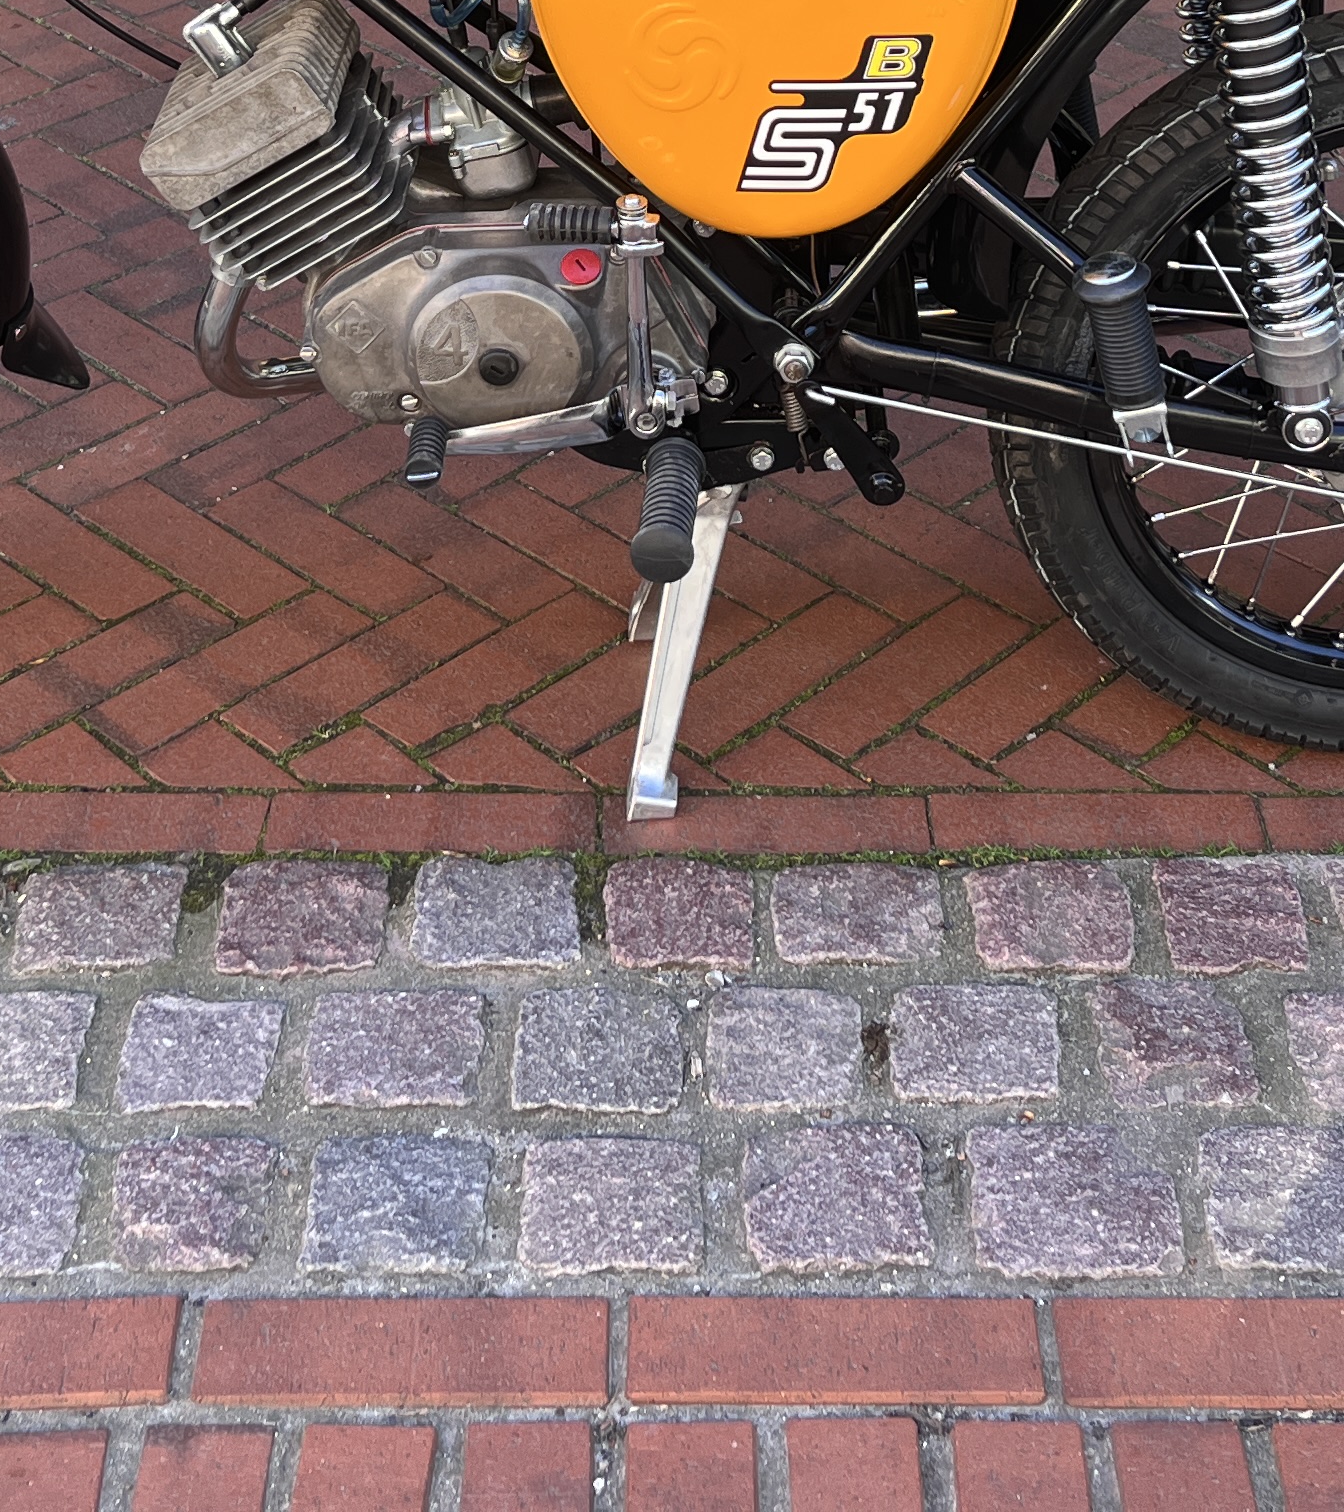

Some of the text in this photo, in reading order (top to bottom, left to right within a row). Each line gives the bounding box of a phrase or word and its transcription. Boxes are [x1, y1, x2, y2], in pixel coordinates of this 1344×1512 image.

[862, 37, 922, 80] B
[335, 320, 375, 337] IFA
[433, 322, 469, 367] 4
